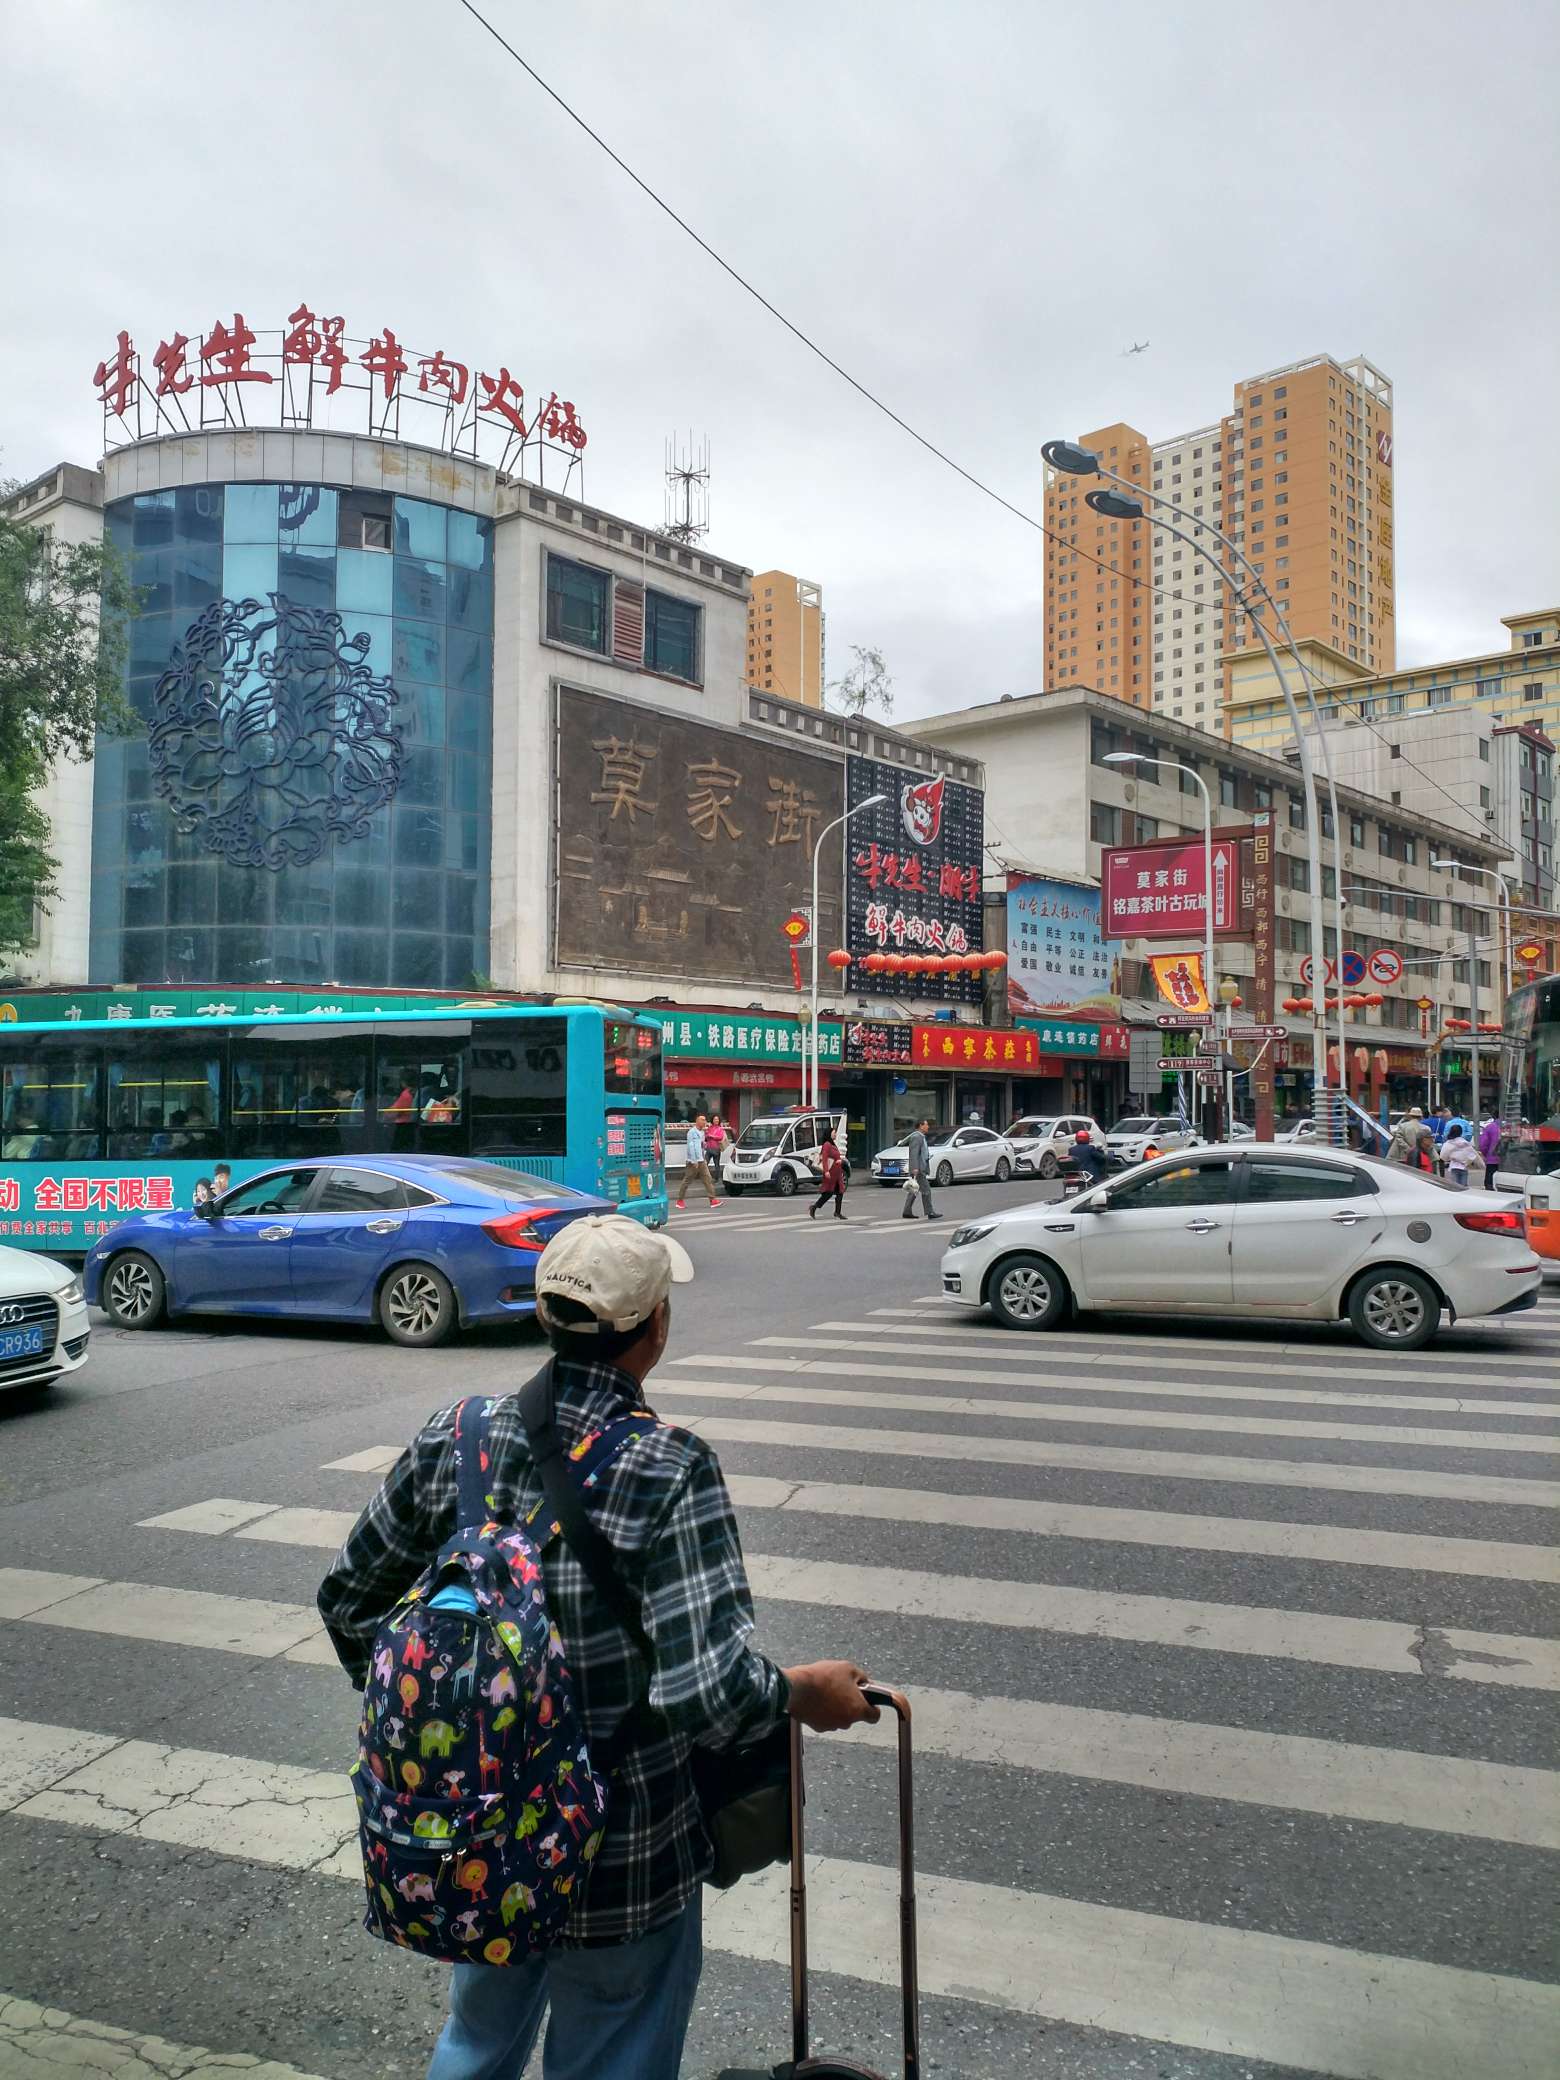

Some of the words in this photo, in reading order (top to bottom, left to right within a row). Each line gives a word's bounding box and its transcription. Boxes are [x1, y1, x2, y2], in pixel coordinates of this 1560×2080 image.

[93, 302, 587, 449] 牛先生鲜牛肉火锅
[591, 735, 822, 862] 莫家街
[1136, 868, 1188, 889] 莫家街
[865, 902, 968, 953] 鲜牛肉火锅
[1020, 922, 1038, 936] 富强
[1046, 926, 1062, 940] 民主
[1069, 931, 1085, 942] 文明
[1021, 940, 1037, 953] 自由
[1046, 944, 1062, 956] 平等
[1069, 948, 1085, 960] 公正
[1020, 957, 1038, 970] 爱国
[1046, 961, 1062, 974] 敬业
[1069, 964, 1085, 977] 诚信
[35, 1178, 174, 1211] 全国不限量
[546, 1272, 592, 1293] NAUTICA
